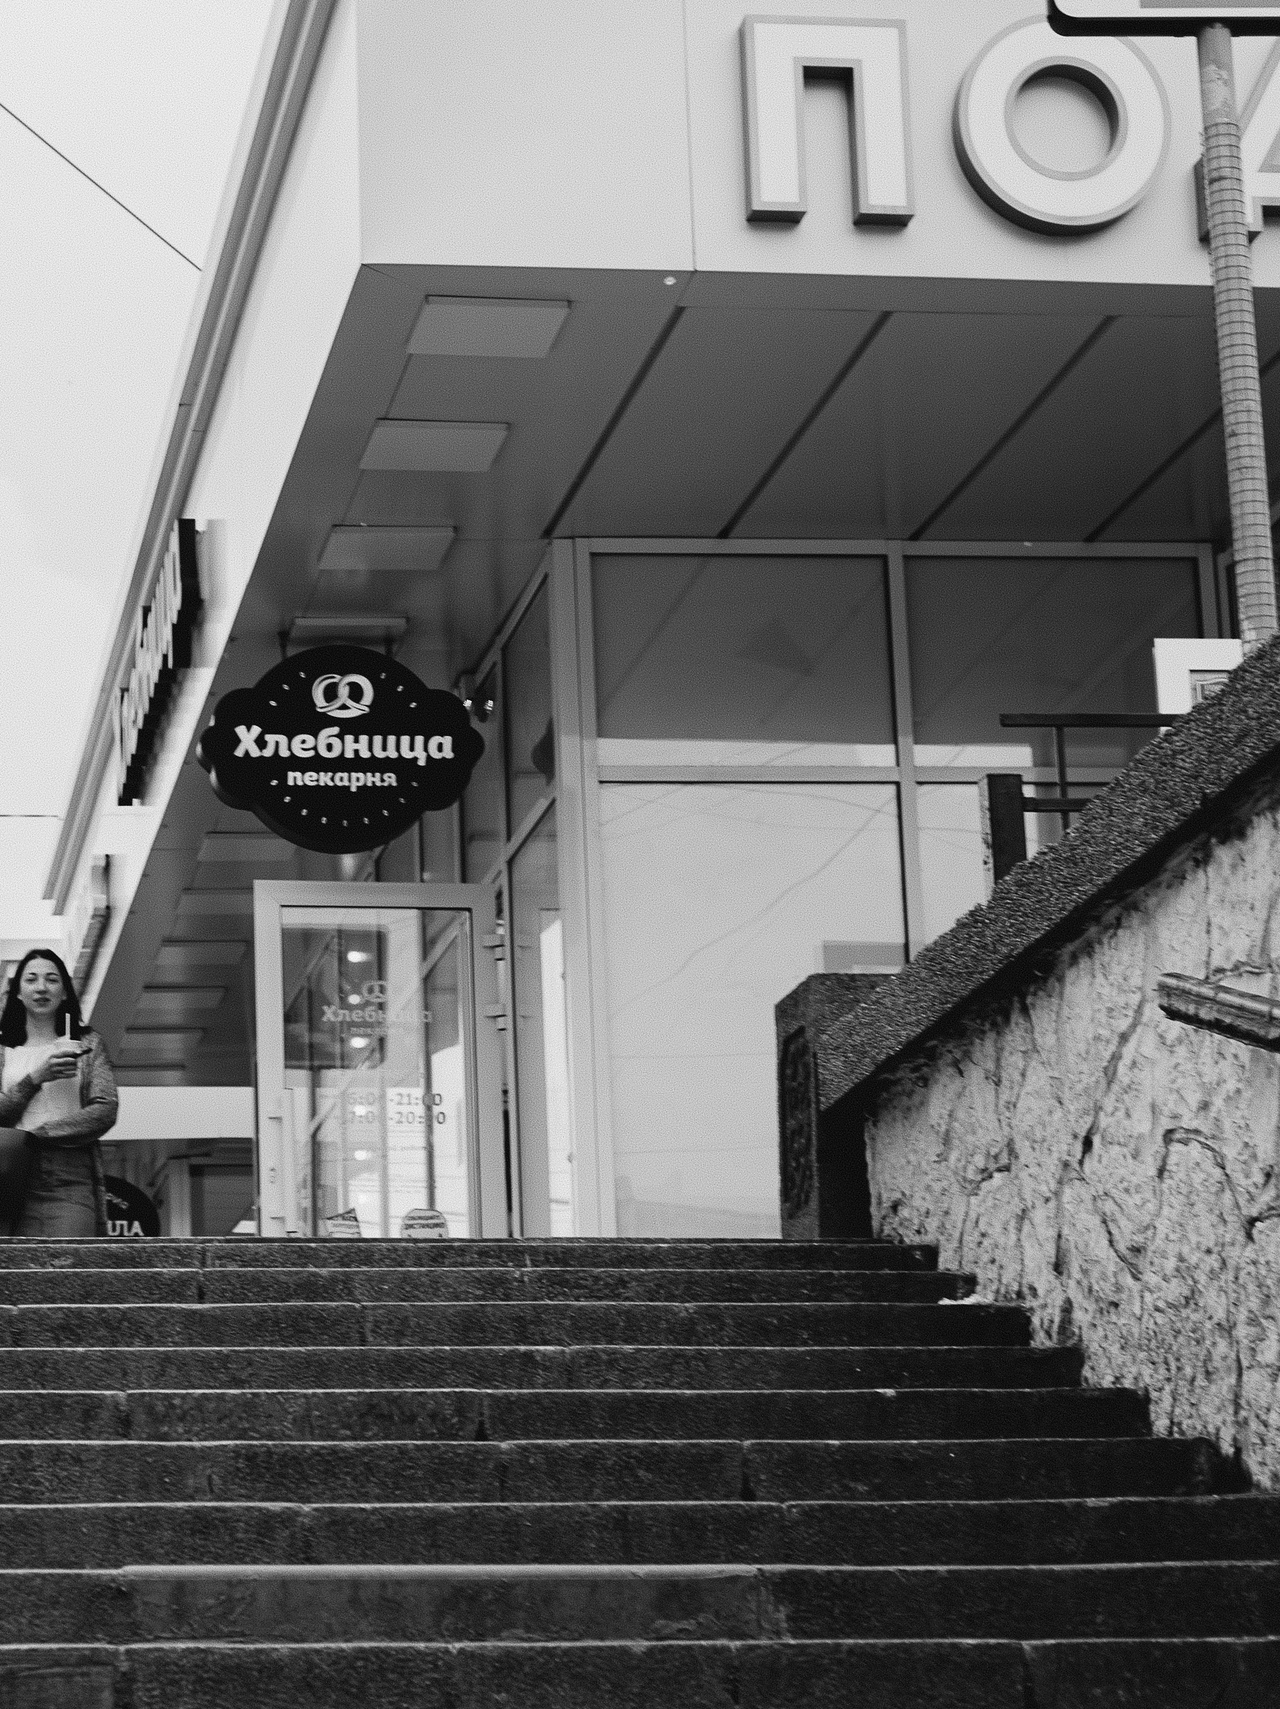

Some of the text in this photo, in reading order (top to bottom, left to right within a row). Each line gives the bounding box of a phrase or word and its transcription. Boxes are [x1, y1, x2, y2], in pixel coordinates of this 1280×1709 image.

[739, 13, 1280, 244] ПО
[233, 725, 455, 766] Хлебница
[287, 771, 398, 792] пекарня
